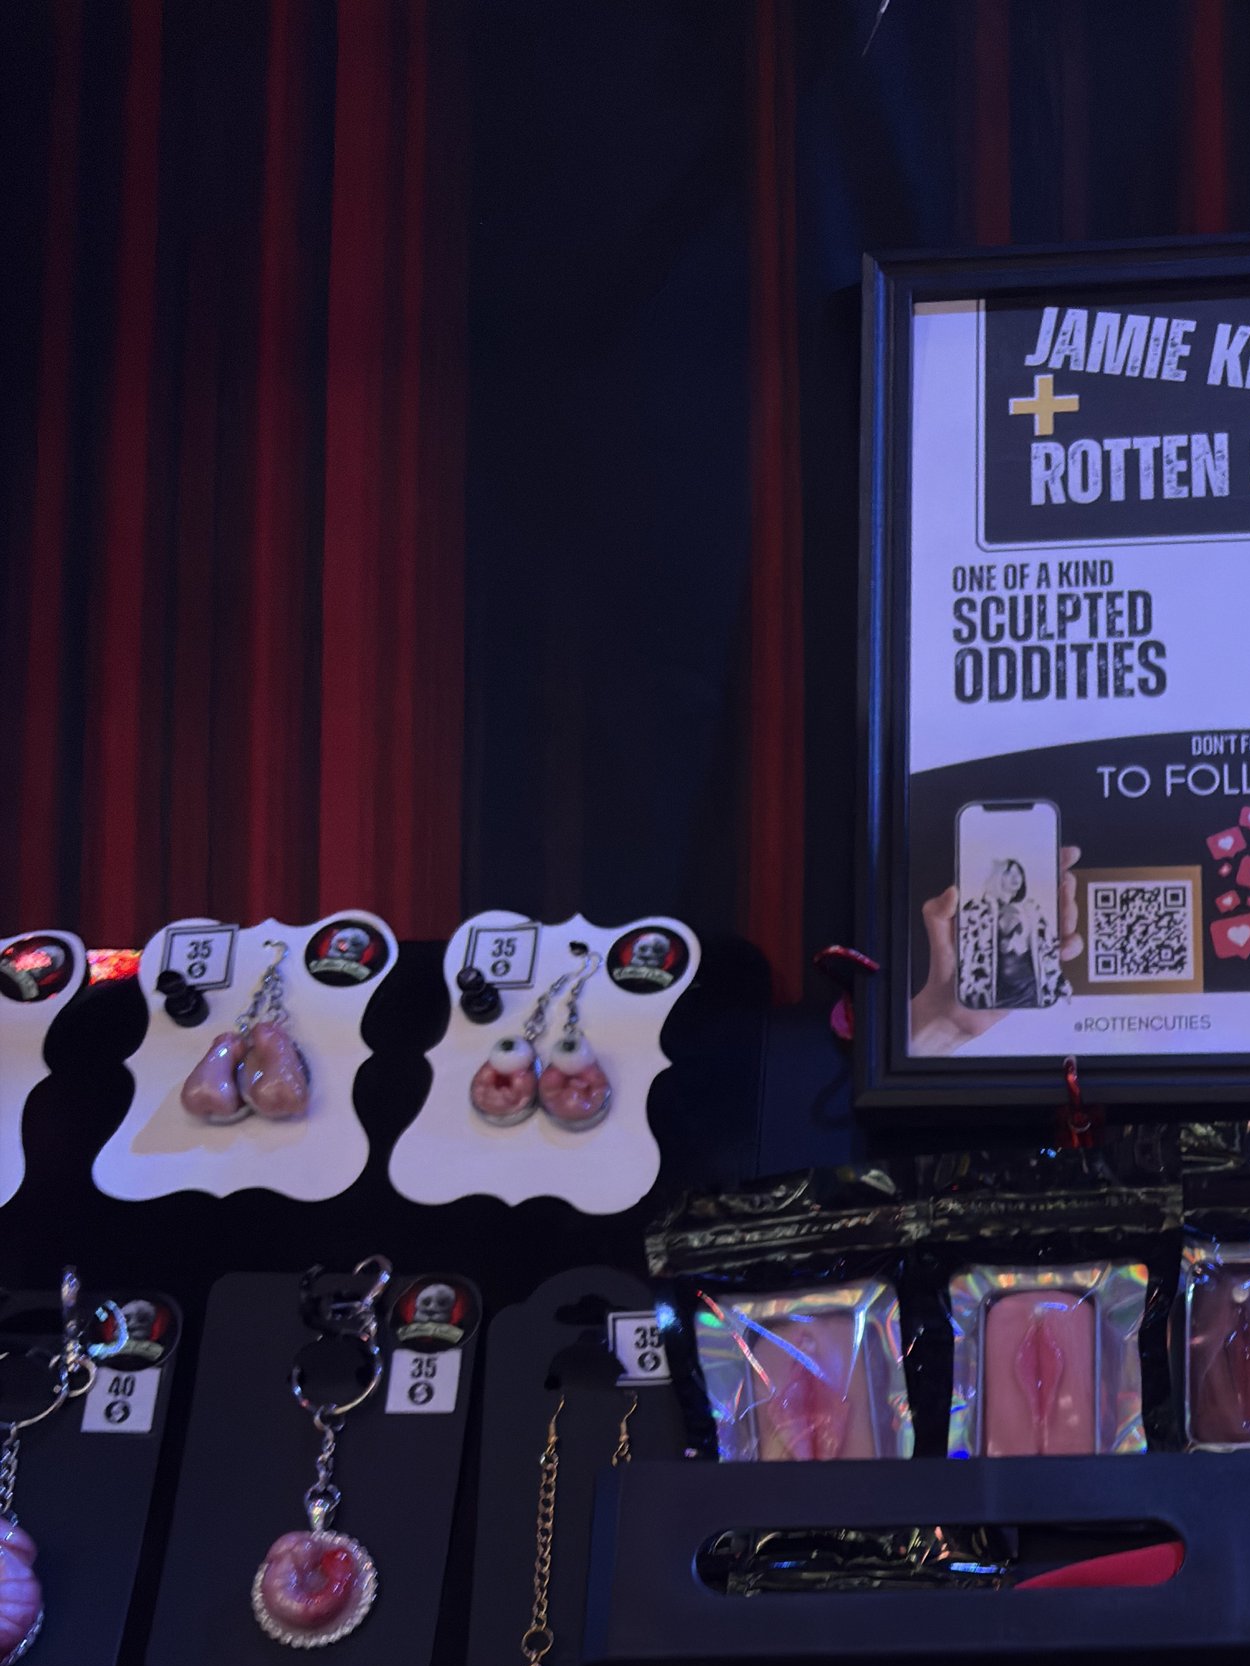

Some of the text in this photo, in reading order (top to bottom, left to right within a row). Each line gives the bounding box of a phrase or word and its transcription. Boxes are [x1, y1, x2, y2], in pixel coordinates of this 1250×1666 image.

[1024, 306, 1196, 382] JAMIE
[1029, 433, 1230, 506] ROTTEN
[952, 559, 1114, 593] ONE OF A KIND
[952, 590, 1153, 645] SCULPTED
[954, 640, 1168, 704] ODDITIES
[1191, 734, 1237, 757] DON'T
[1096, 765, 1151, 799] TO
[188, 940, 212, 960] 35
[492, 938, 516, 958] 35
[1073, 1013, 1211, 1033] @ROTTENCUTIES
[633, 1326, 661, 1349] 35
[411, 1358, 437, 1379] 35
[108, 1375, 135, 1398] 40
